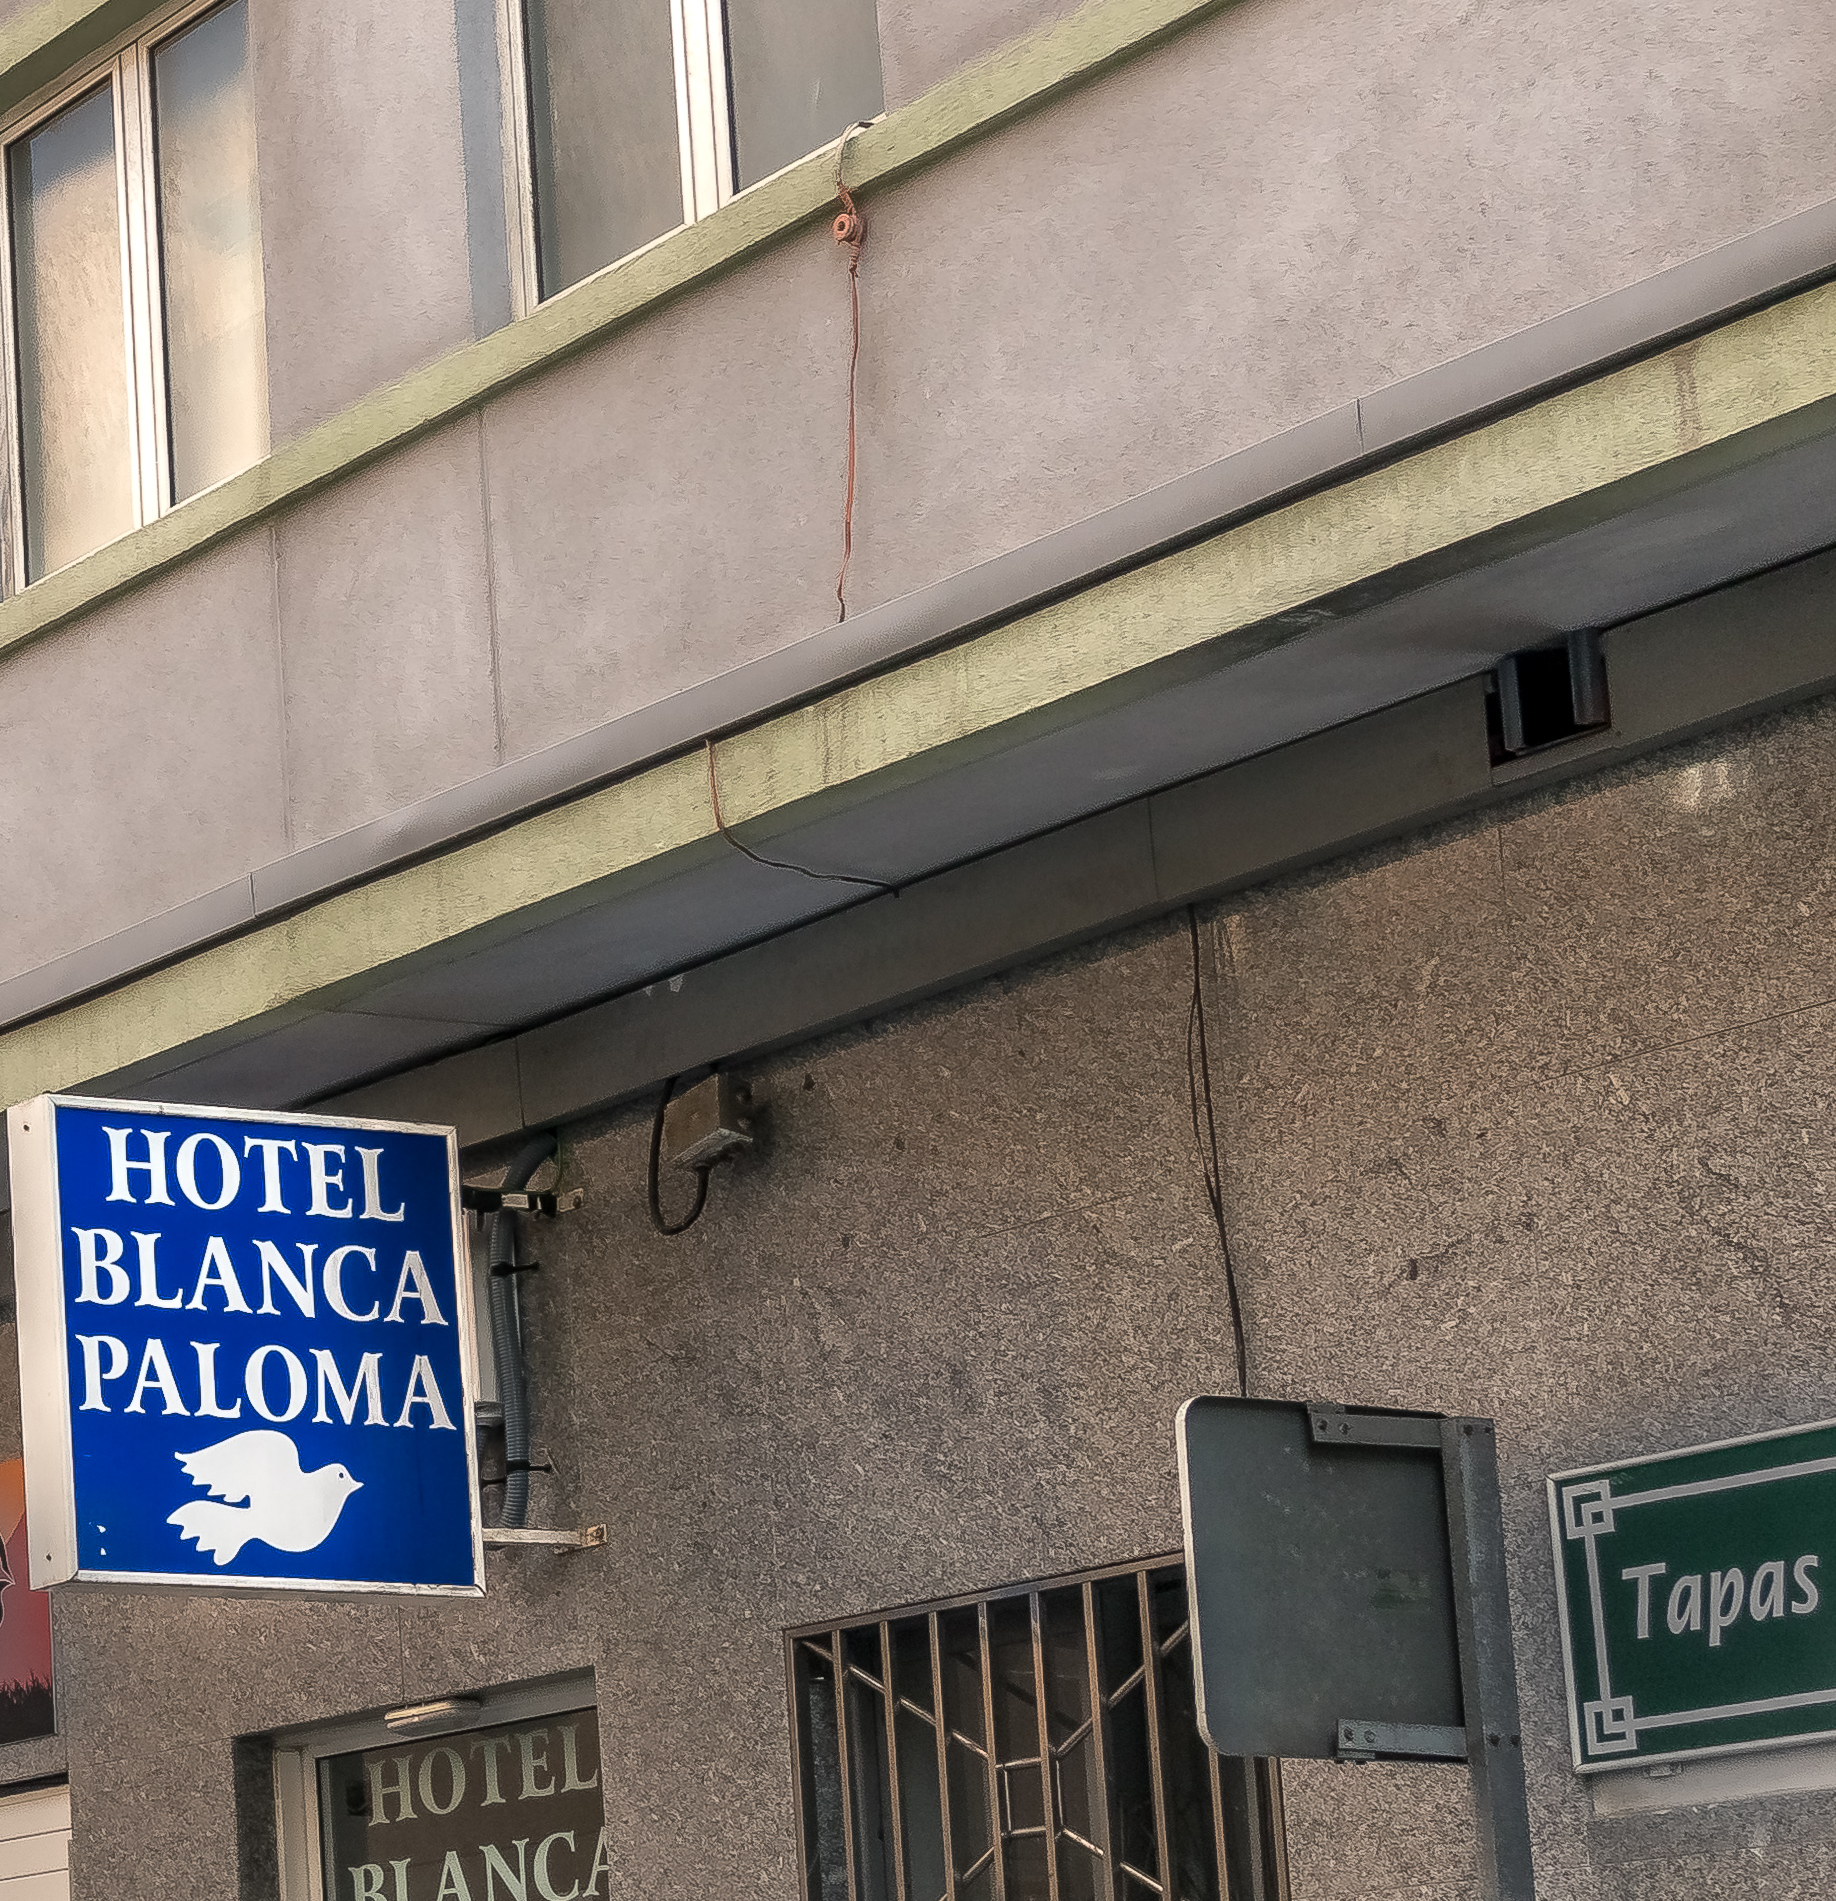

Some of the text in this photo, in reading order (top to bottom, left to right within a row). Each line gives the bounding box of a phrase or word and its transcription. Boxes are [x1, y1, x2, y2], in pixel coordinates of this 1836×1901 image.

[101, 1125, 405, 1223] HOTEL
[71, 1226, 449, 1326] BLANCA
[75, 1333, 457, 1431] PALOMA
[1621, 1554, 1820, 1647] Tapas
[368, 1723, 598, 1827] HOTEL
